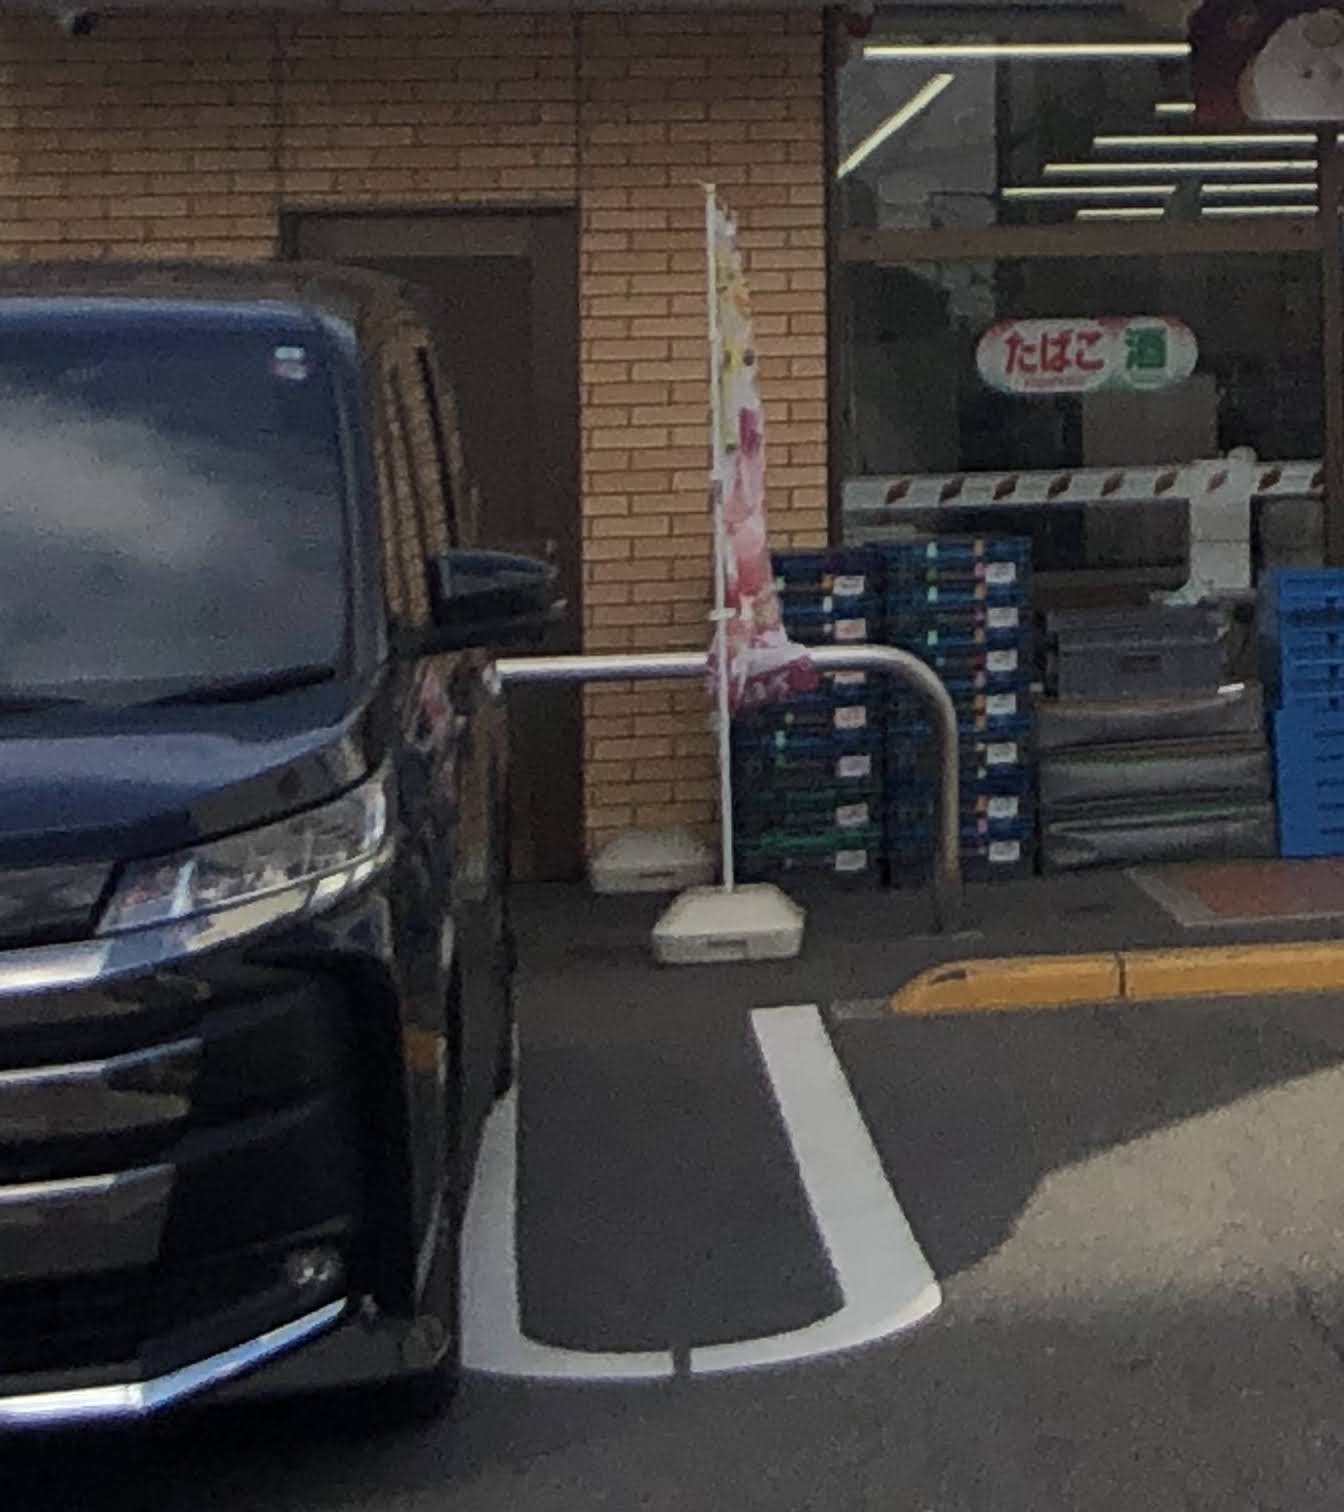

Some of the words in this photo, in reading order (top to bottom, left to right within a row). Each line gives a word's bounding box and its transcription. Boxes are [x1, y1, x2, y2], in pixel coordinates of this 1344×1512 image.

[1004, 330, 1105, 374] たばこ
[1125, 326, 1167, 369] 酒
